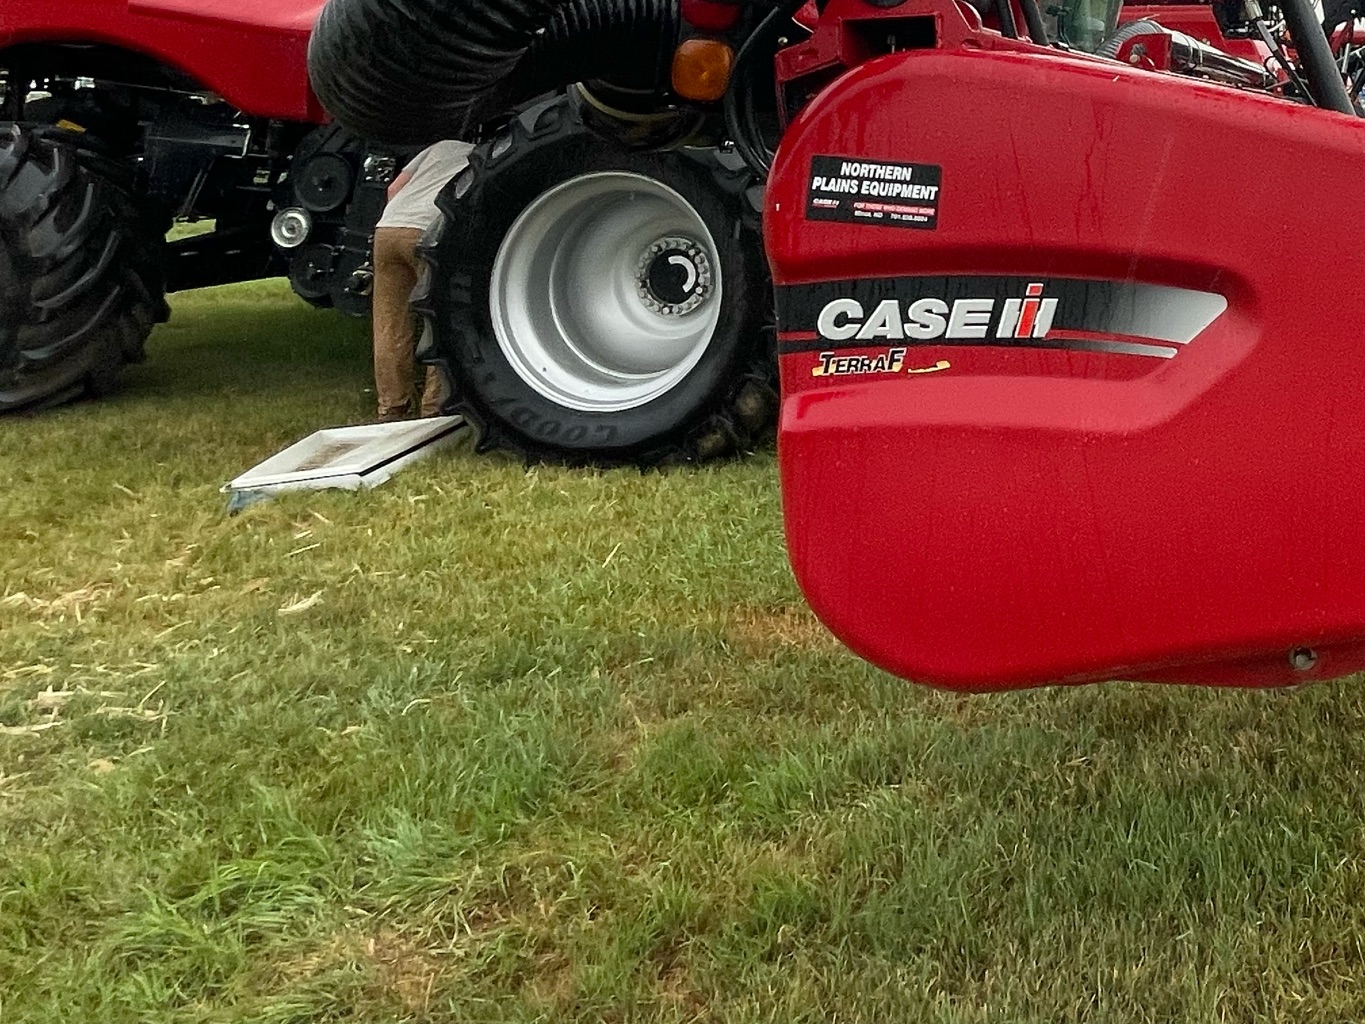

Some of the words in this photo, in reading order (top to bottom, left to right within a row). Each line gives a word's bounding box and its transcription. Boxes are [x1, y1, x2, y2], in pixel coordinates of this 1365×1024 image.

[840, 162, 912, 181] NORTHERN
[812, 176, 859, 194] PLAINS
[861, 180, 938, 201] EQUIPMENT
[816, 298, 995, 340] CASE
